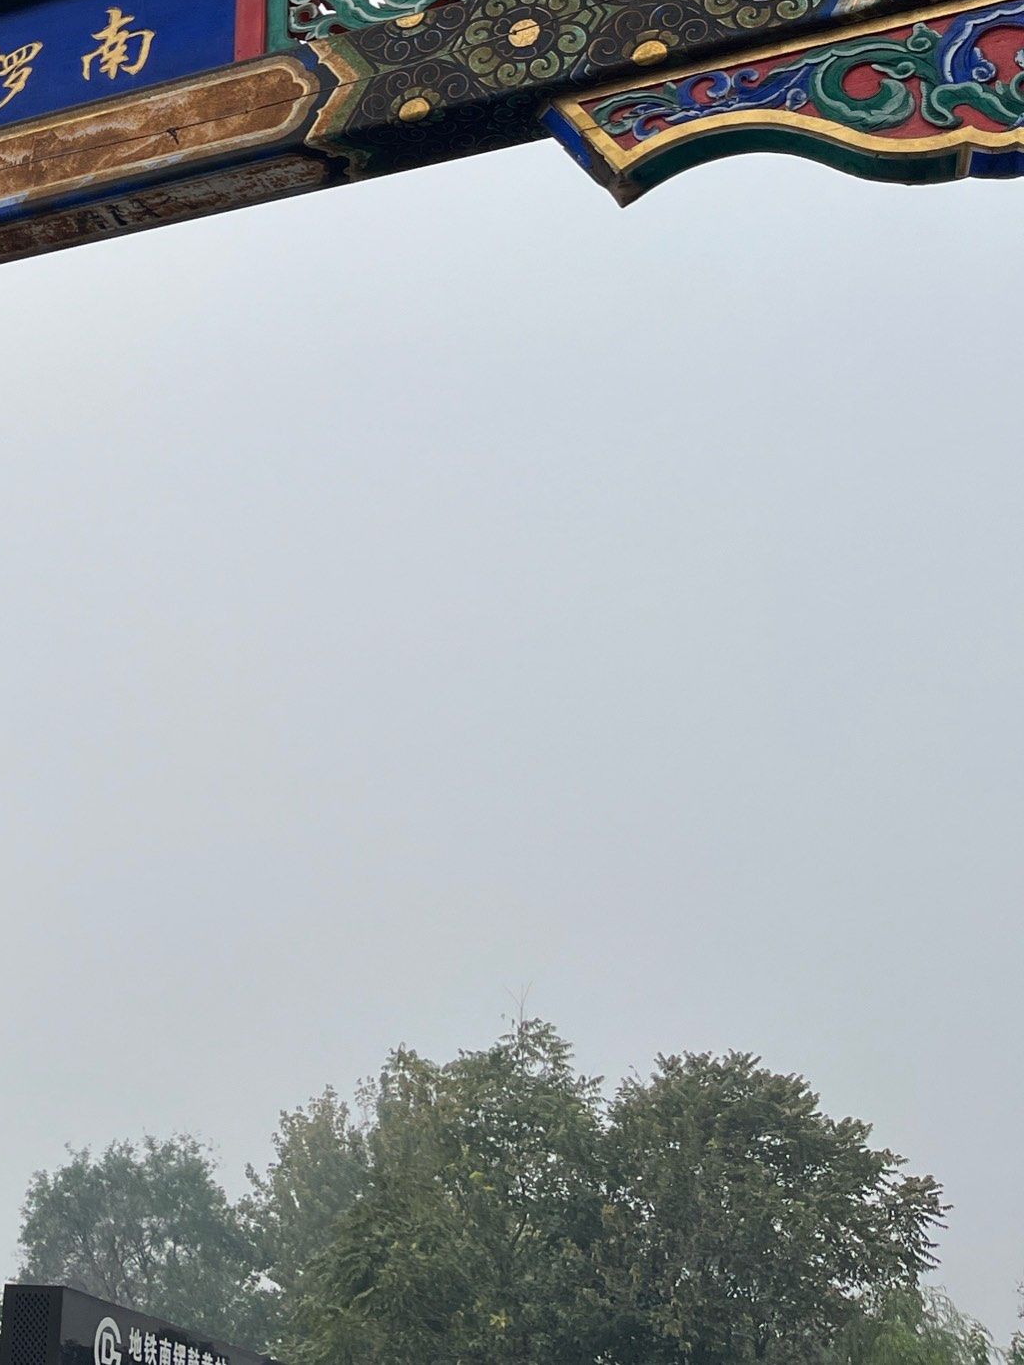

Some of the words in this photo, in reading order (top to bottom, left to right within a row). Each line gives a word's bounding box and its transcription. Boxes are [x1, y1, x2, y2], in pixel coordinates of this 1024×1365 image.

[129, 1327, 226, 1365] 地铁南锣鼓
